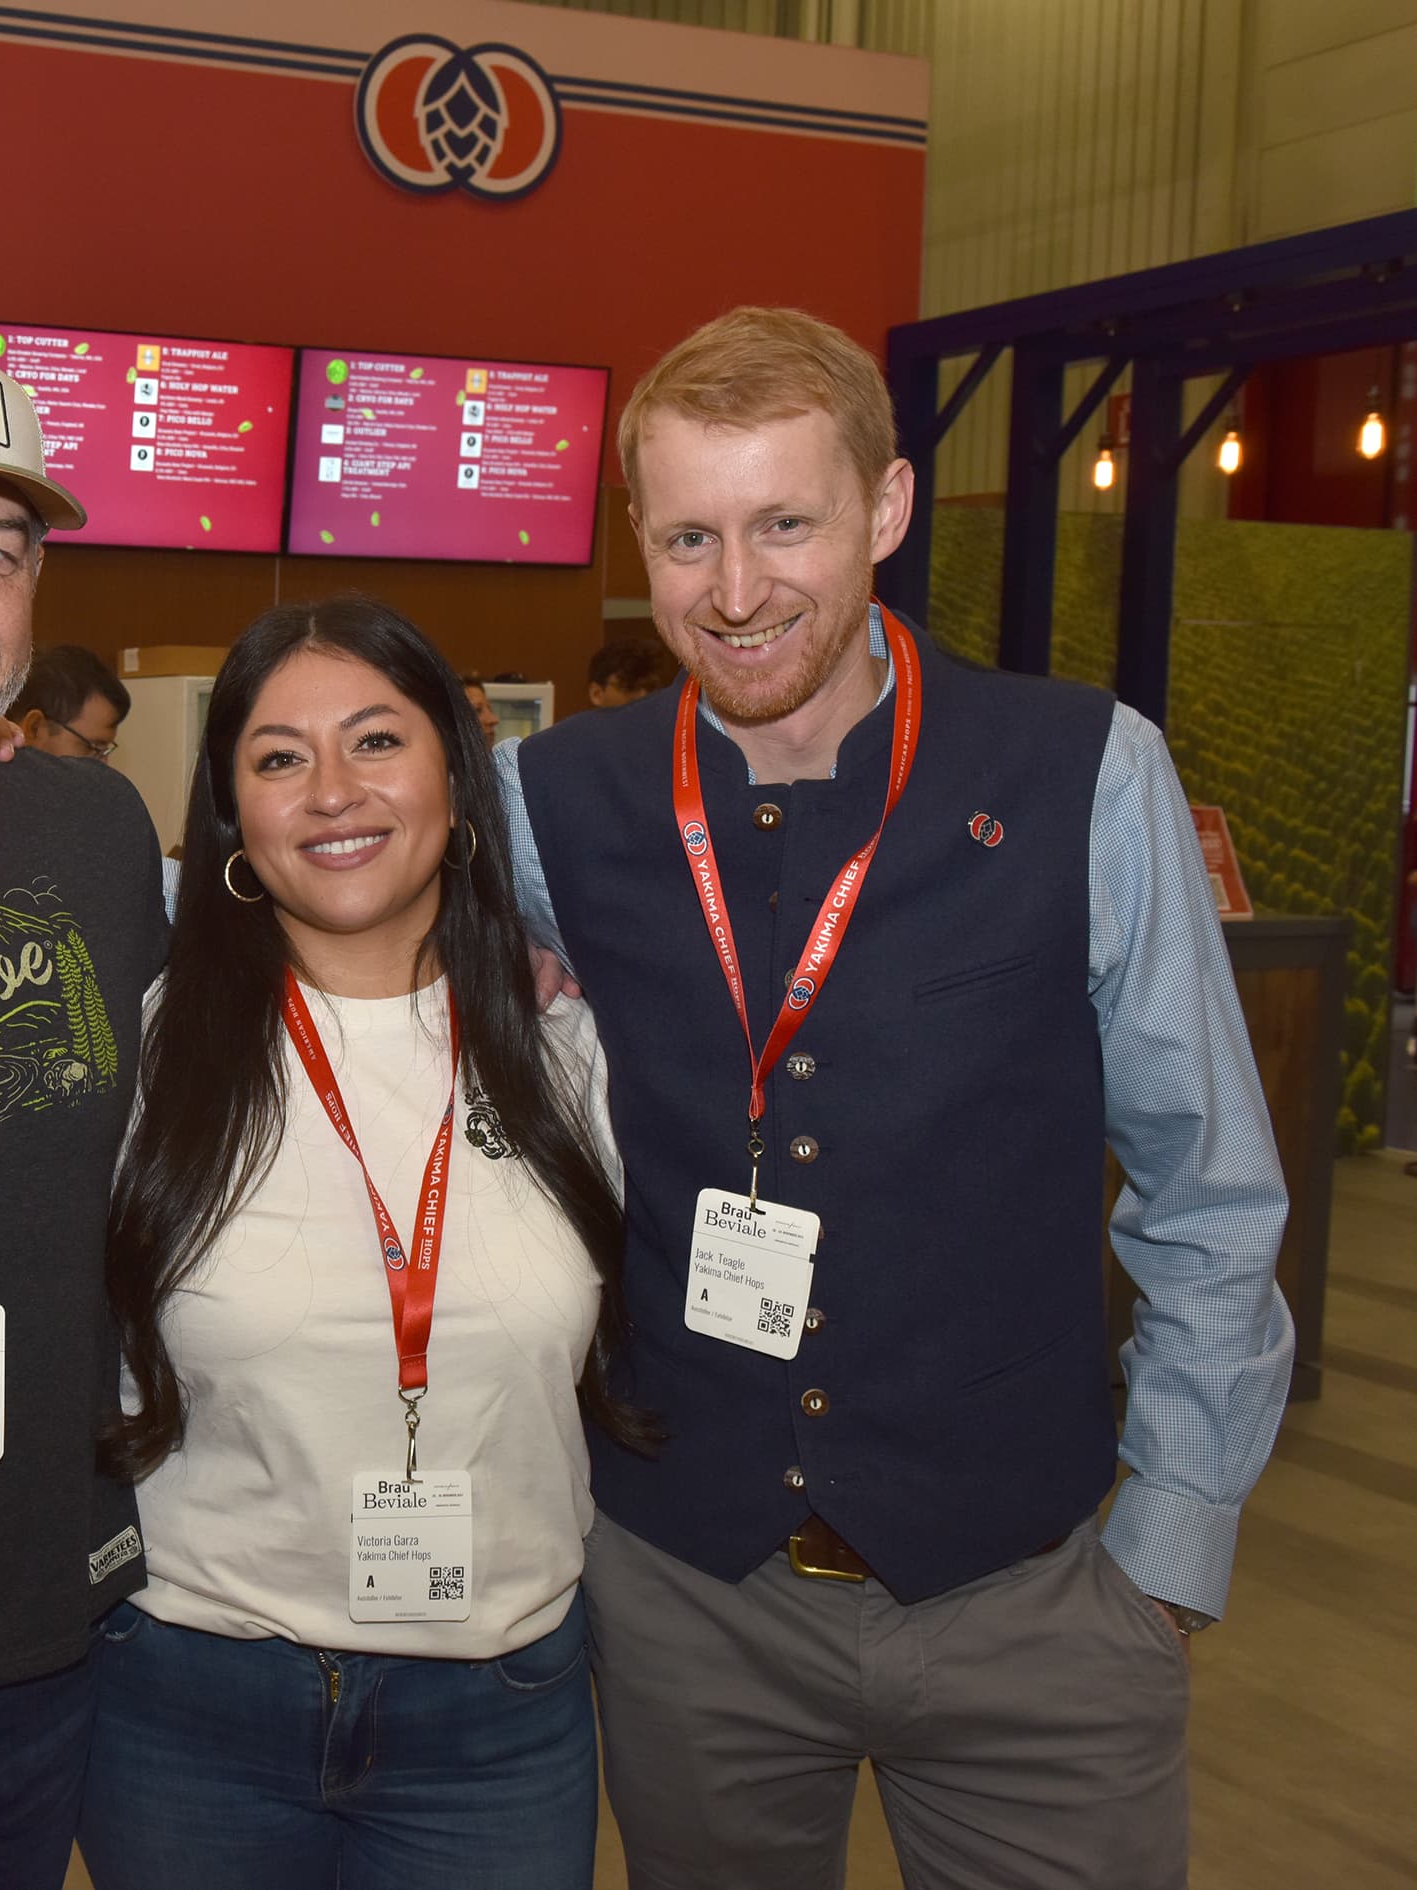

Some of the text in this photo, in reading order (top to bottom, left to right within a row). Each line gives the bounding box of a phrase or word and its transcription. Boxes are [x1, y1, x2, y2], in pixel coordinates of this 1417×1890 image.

[896, 743, 909, 791] AMERICAN
[697, 859, 721, 923] YAKIMA
[715, 926, 736, 973] CHIEF
[805, 912, 840, 972] YAKIMA
[832, 860, 860, 908] CHIEF
[296, 1019, 317, 1061] AMERICAN
[325, 1091, 342, 1122] HOPS
[420, 1127, 448, 1271] YAKIMA CHIEF HOPS
[721, 1201, 752, 1221] Brau
[704, 1209, 767, 1239] Beviale
[695, 1248, 745, 1271] Jack Teagle
[694, 1262, 765, 1290] Yakima Chief Hops
[700, 1288, 709, 1302] A
[362, 1492, 427, 1509] Beviale
[378, 1481, 410, 1494] Brau
[91, 1535, 137, 1572] VARIETEES
[357, 1534, 419, 1547] Victoria Garza
[357, 1550, 432, 1562] Yakima Chief Hops
[366, 1575, 375, 1588] A
